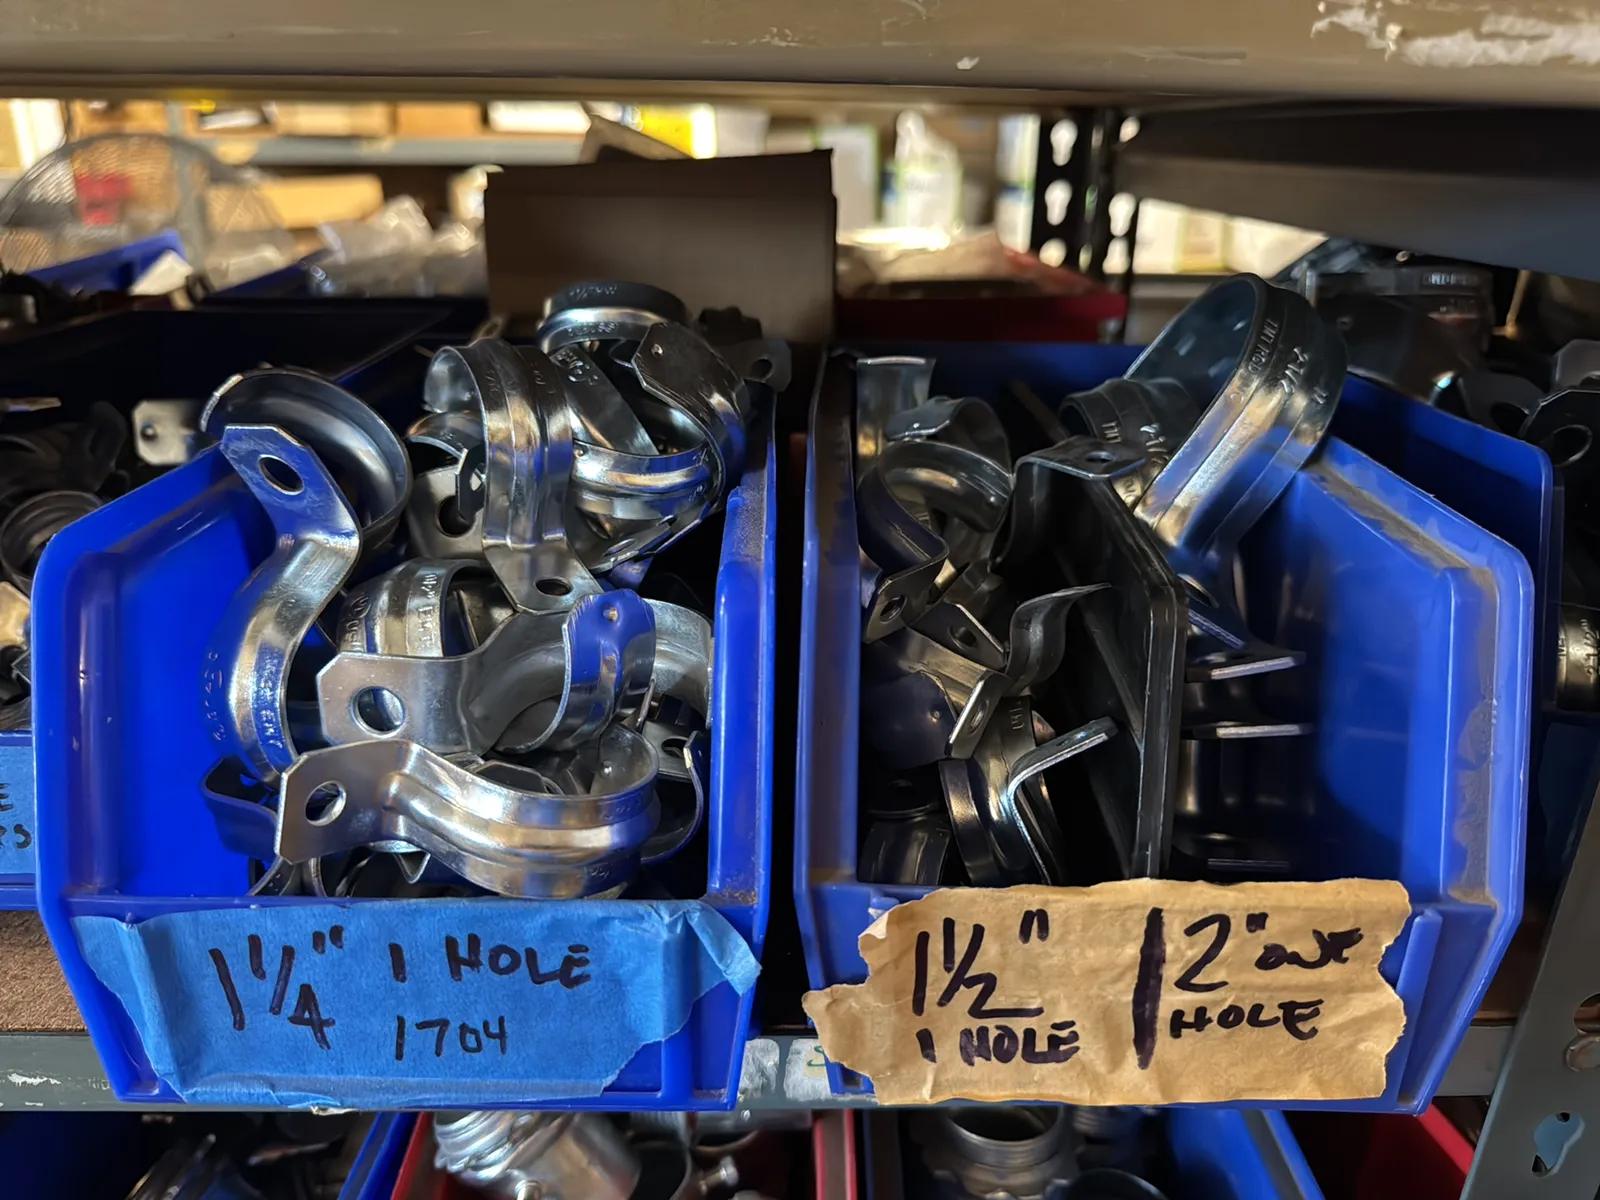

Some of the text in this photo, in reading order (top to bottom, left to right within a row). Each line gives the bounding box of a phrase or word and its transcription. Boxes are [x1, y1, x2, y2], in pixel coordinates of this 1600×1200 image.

[388, 942, 408, 984] 1
[444, 932, 591, 990] HOLE
[395, 1015, 508, 1062] 1704
[1169, 998, 1325, 1041] HOLE
[915, 1020, 1081, 1067] 1 HOLE
